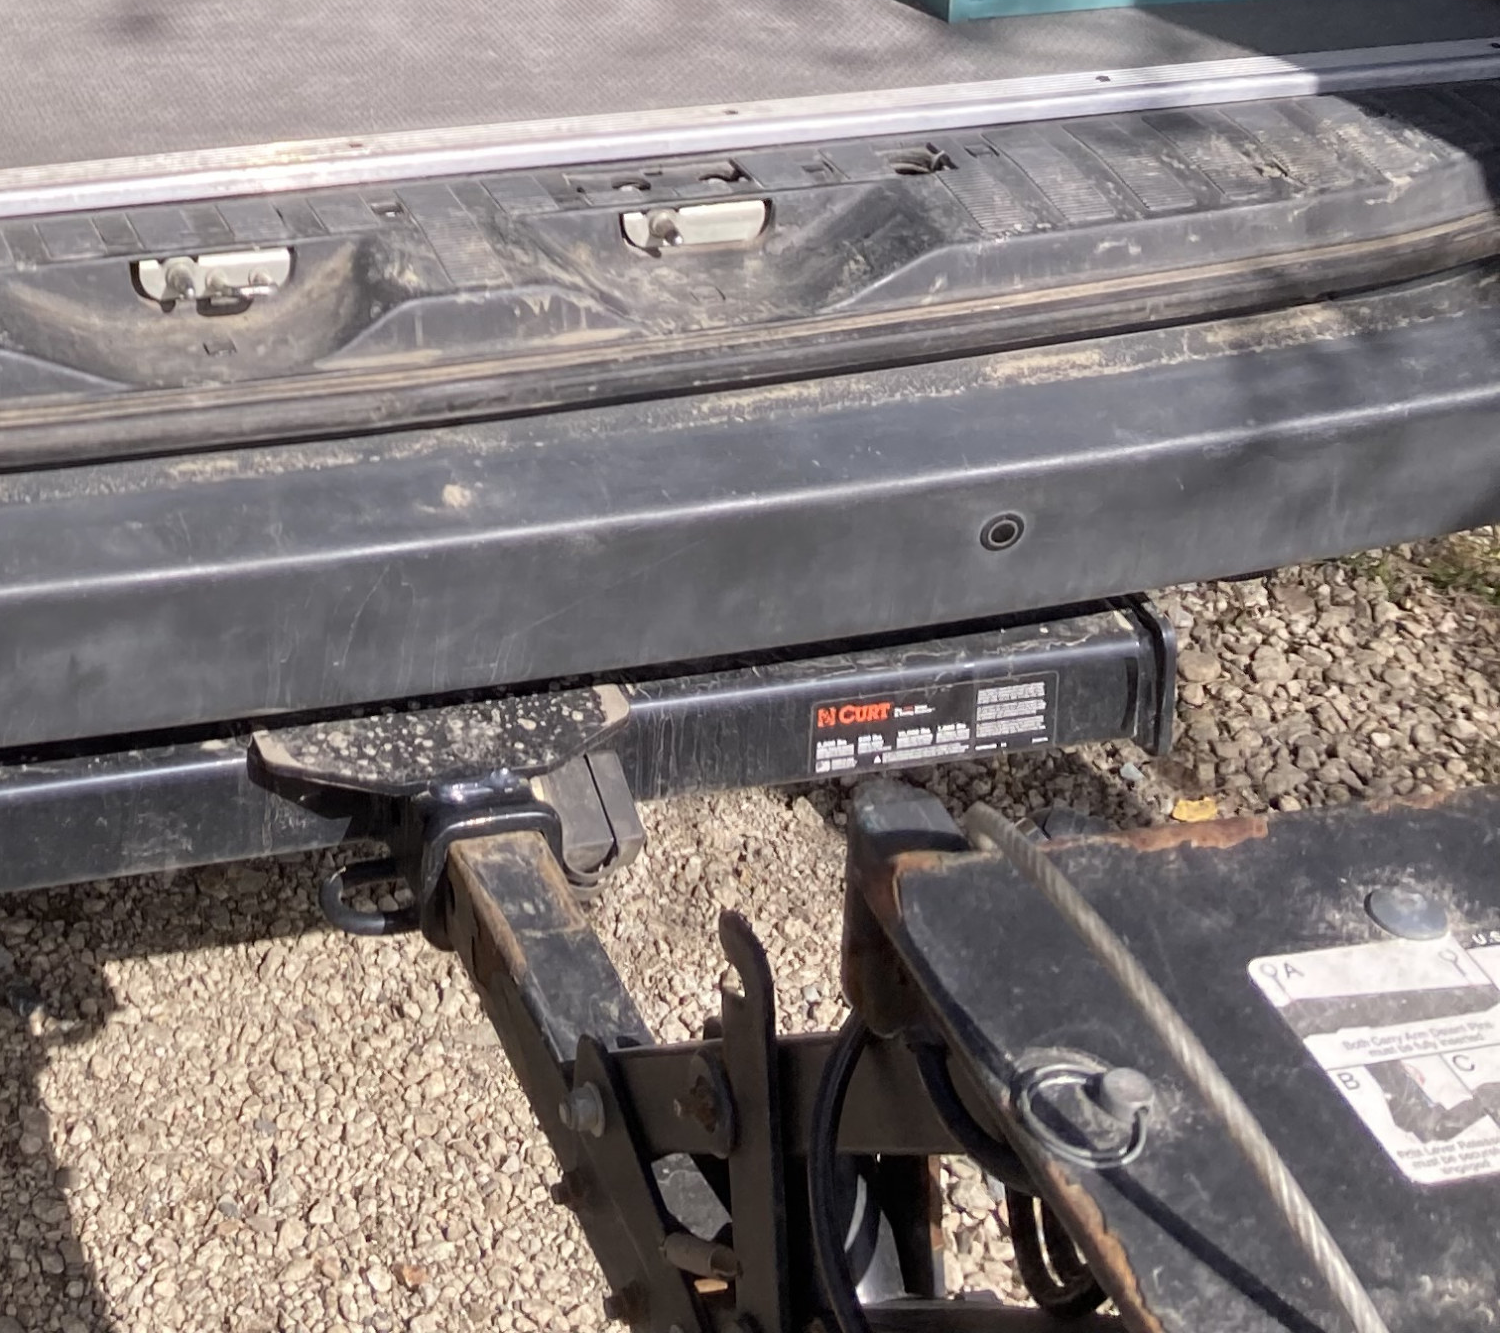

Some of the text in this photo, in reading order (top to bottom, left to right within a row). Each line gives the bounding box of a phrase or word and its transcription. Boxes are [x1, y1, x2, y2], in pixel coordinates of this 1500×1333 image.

[838, 701, 891, 725] CURT
[1283, 962, 1304, 978] A
[1452, 1055, 1474, 1072] C
[1337, 1073, 1359, 1090] B
